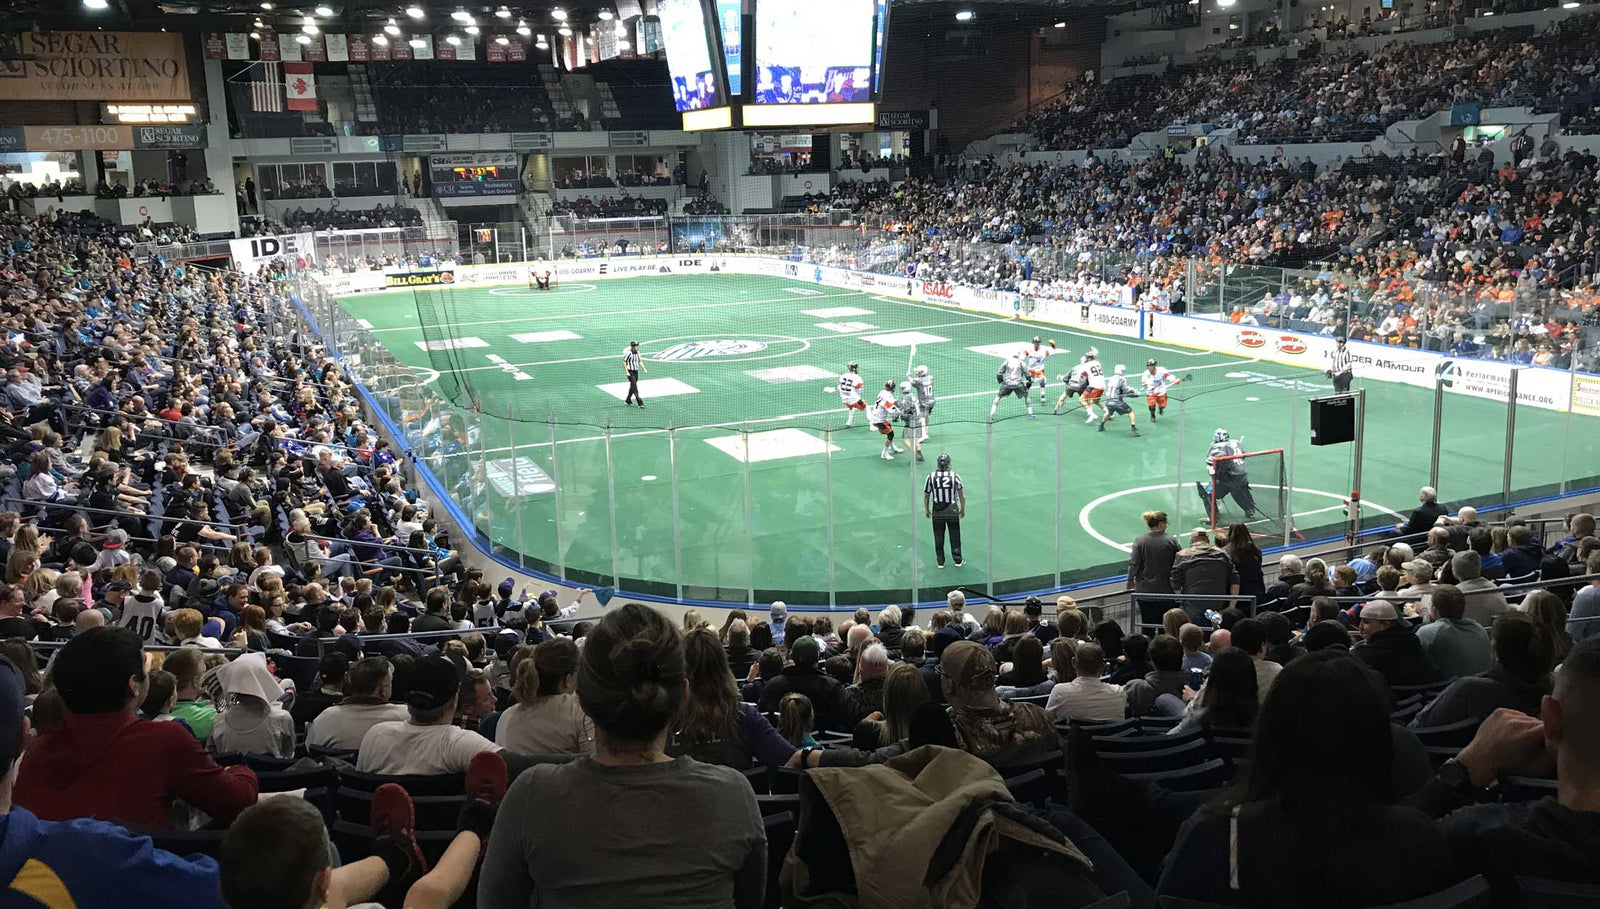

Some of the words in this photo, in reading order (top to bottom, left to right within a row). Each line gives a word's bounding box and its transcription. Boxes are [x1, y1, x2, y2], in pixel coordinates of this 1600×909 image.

[30, 32, 121, 54] SEGAR
[34, 57, 179, 79] SCIORTINO
[40, 127, 119, 144] 475-1100
[155, 127, 182, 135] SEGAR
[155, 134, 199, 143] SCIORTINO
[250, 236, 299, 257] IDE
[386, 275, 410, 287] BILL
[410, 273, 441, 285] GRAY'S
[922, 281, 953, 299] ISAAC
[973, 289, 998, 300] RICOH
[1093, 313, 1138, 328] 1-800-GOARMY
[1375, 358, 1425, 374] ARMOUR
[840, 377, 854, 392] 22
[934, 476, 950, 489] 12
[124, 615, 155, 641] 40
